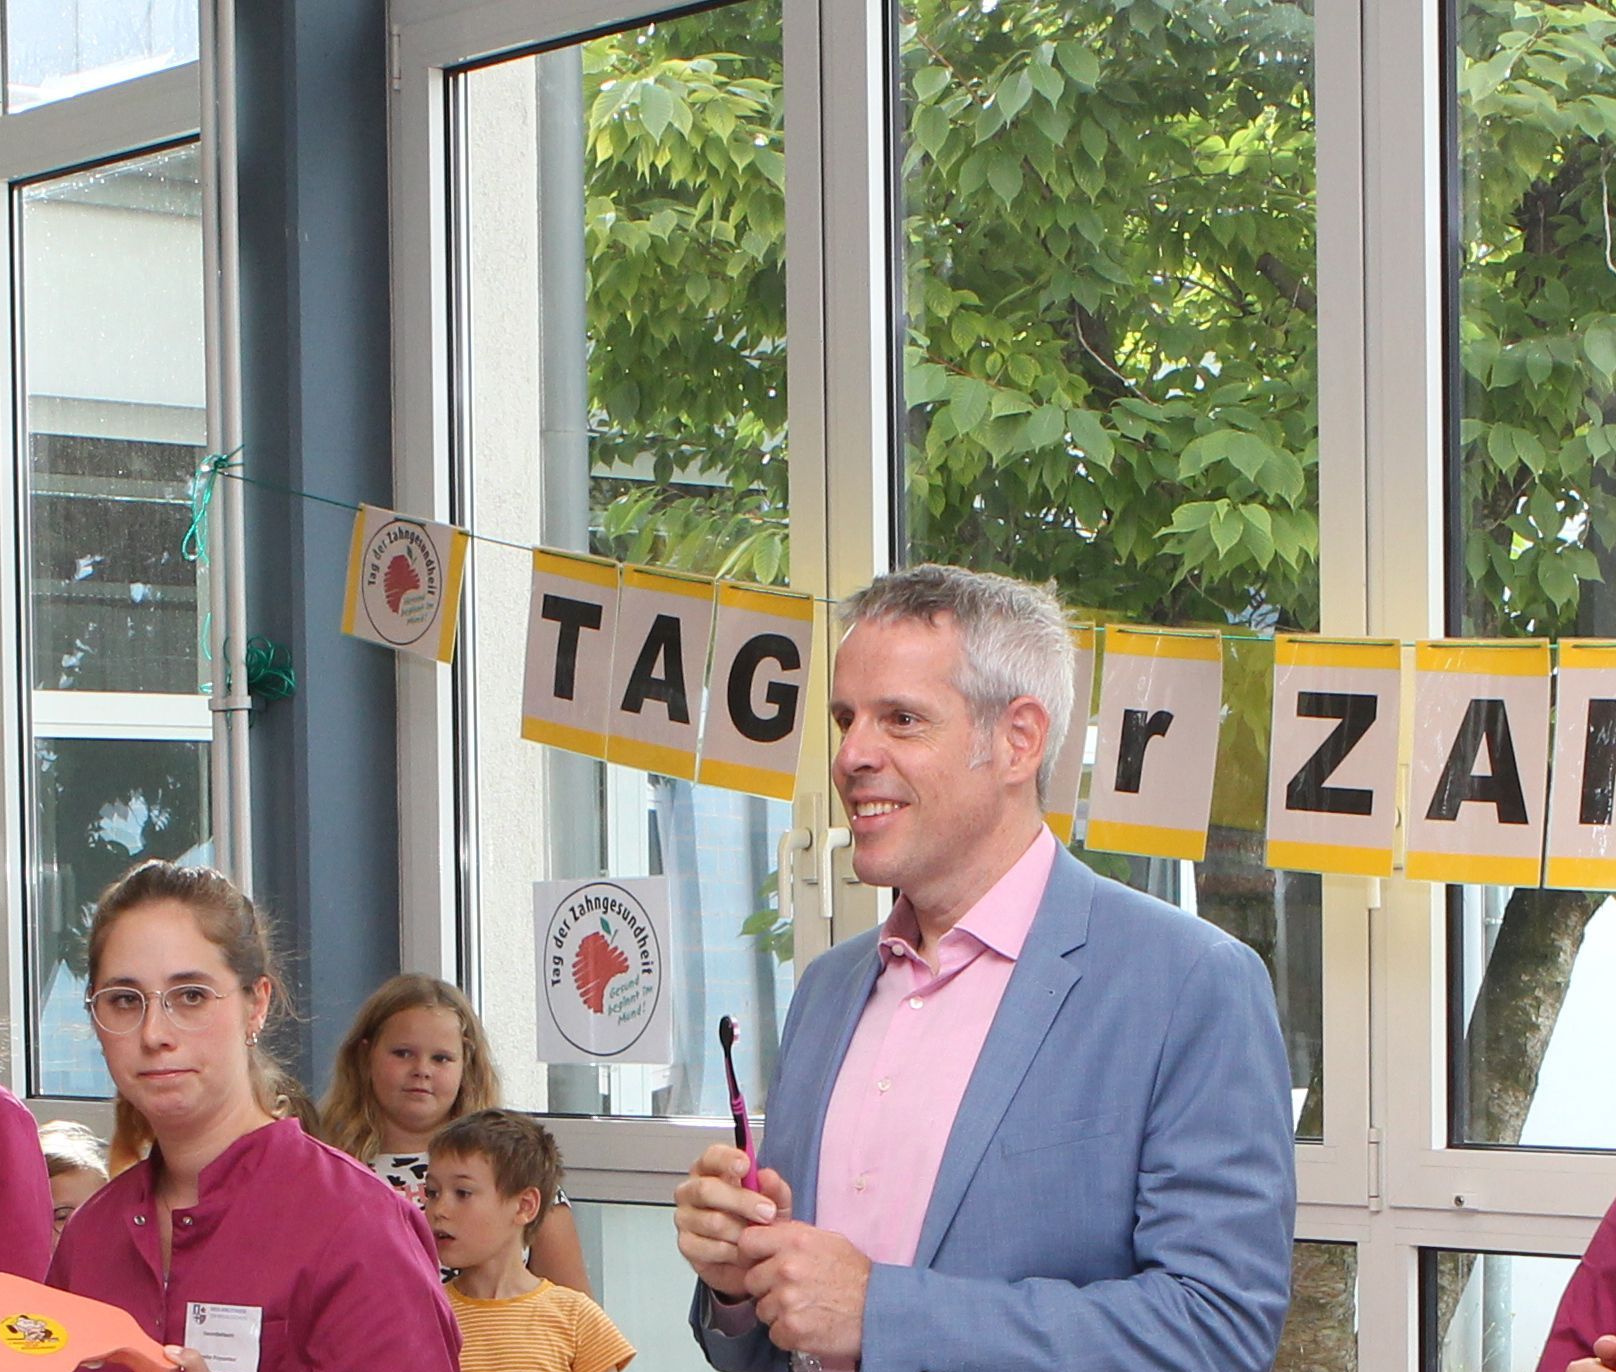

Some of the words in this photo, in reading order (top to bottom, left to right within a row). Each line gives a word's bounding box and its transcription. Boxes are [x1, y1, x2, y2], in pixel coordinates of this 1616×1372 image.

[373, 540, 388, 561] der
[386, 526, 438, 596] Zahngesundheit
[367, 563, 381, 586] Tag
[541, 592, 801, 744] TAG
[553, 919, 572, 949] der
[569, 894, 654, 975] Zahngesundheit
[551, 955, 564, 987] Tag
[617, 1001, 646, 1026] Mund!
